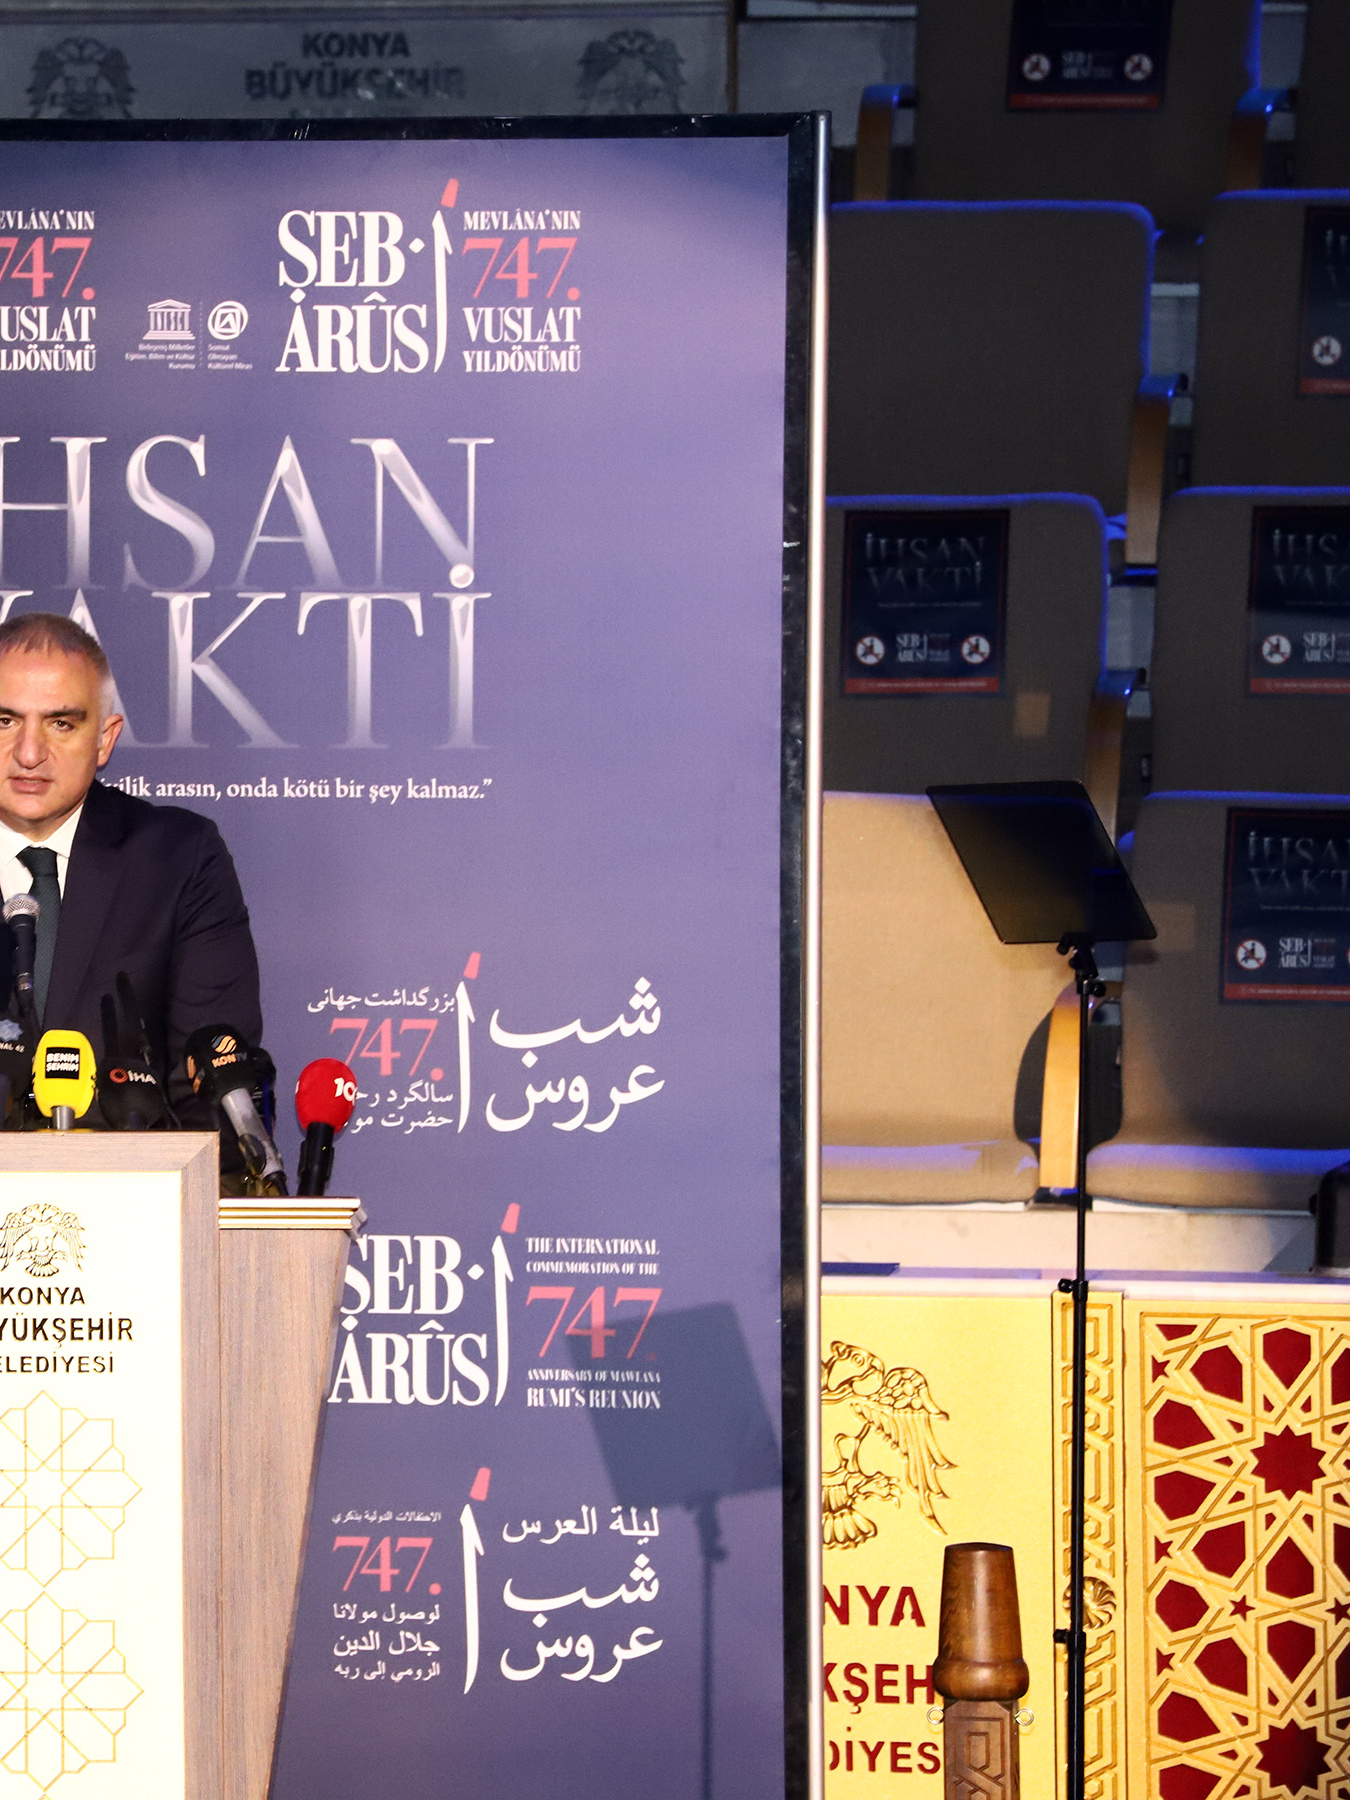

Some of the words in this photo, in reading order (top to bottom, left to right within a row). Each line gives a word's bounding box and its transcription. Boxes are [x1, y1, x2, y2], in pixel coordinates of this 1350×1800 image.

[302, 32, 409, 57] KONYA
[462, 307, 581, 343] VUSLAT
[462, 345, 581, 373] YILDÖNÜMÜ
[155, 777, 221, 801] arasın,
[226, 776, 279, 798] onda
[282, 777, 331, 798] kötü
[335, 776, 365, 799] bir
[369, 783, 402, 805] şey
[307, 987, 362, 1013] جهانی
[364, 986, 456, 1013] بزرگداشت
[489, 976, 662, 1069] شب
[387, 1079, 454, 1110] سالگرد
[485, 1064, 665, 1133] عروس
[380, 1110, 454, 1135] حضرت
[526, 1237, 554, 1254] THE
[555, 1237, 660, 1256] INTERNATIONAL
[621, 1262, 636, 1275] OF
[638, 1262, 660, 1276] THE
[0, 1286, 86, 1306] KONYA
[594, 1369, 608, 1382] OF
[588, 1389, 662, 1409] REUNION
[502, 1505, 598, 1544] العرس
[609, 1506, 661, 1546] ليلة
[333, 1603, 378, 1624] مولانا
[382, 1603, 441, 1625] لوصول
[333, 1629, 381, 1657] الدين
[388, 1630, 441, 1657] جلال
[499, 1625, 664, 1683] عروس
[334, 1664, 361, 1680] ربه
